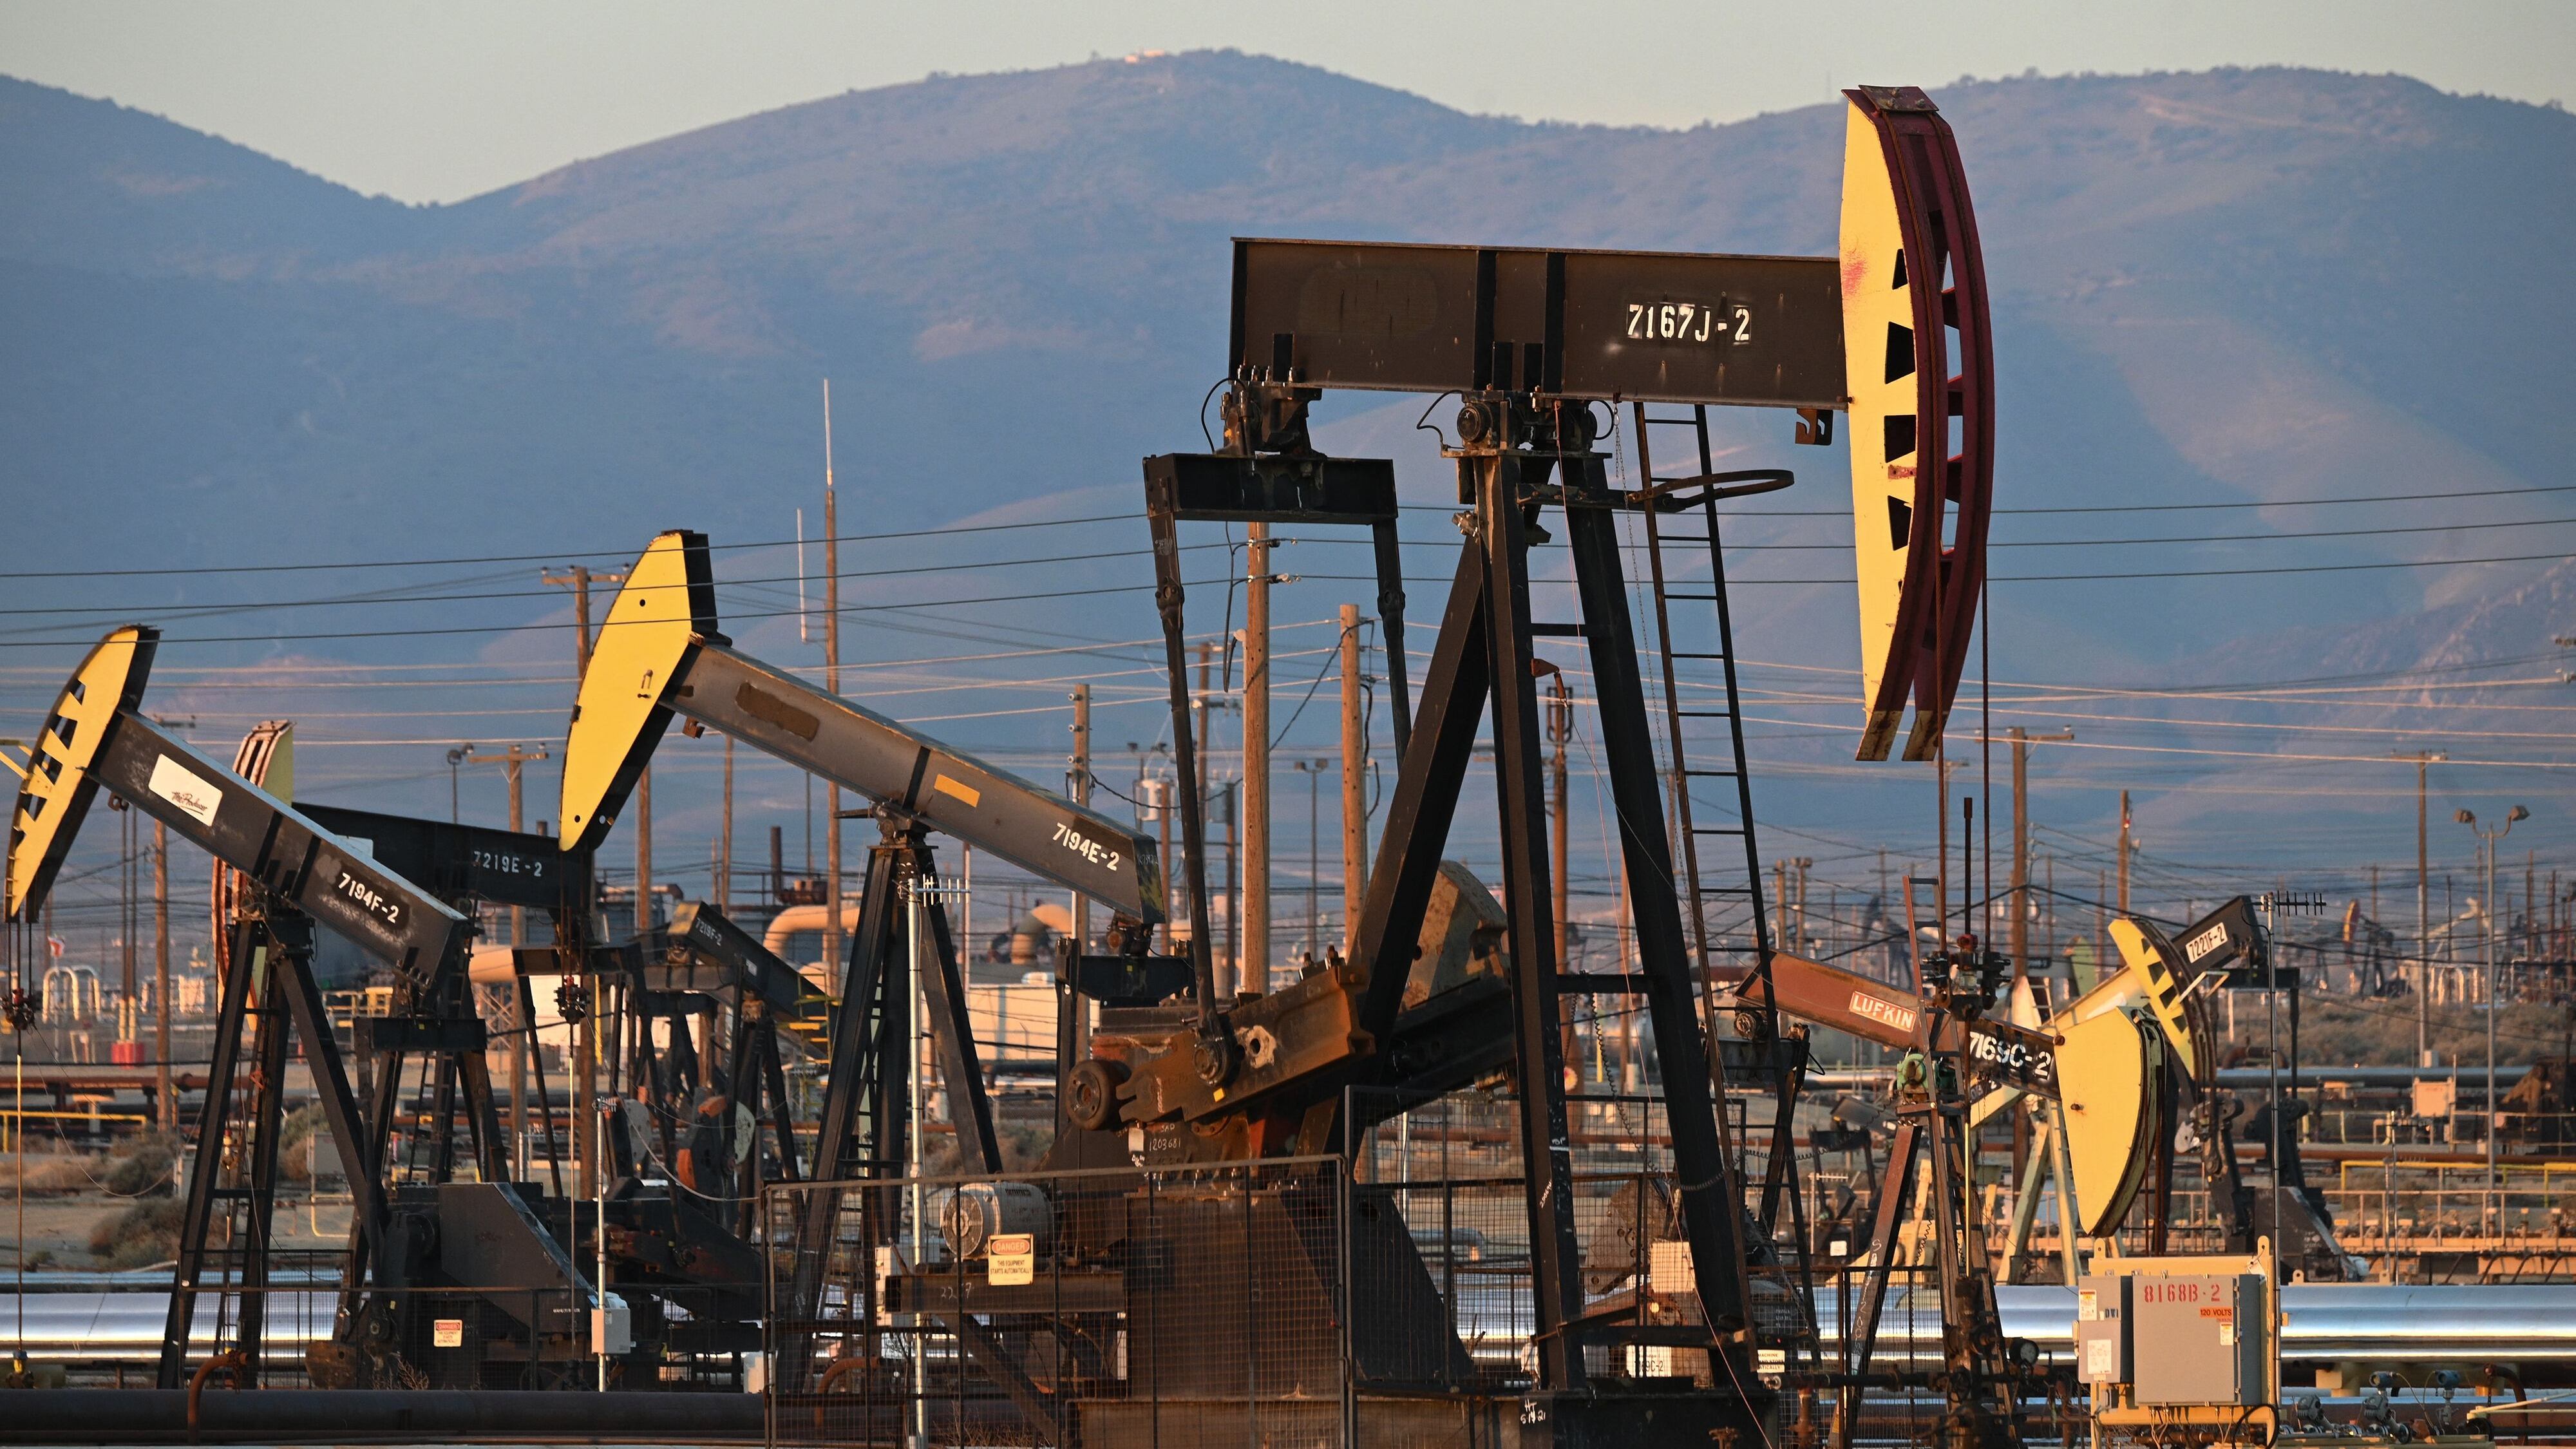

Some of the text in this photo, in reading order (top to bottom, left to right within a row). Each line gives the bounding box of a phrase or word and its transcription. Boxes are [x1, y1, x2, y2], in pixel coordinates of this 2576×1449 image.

[1627, 304, 1749, 342] 7167J-2
[1052, 822, 1119, 871] 7194E-2
[473, 851, 542, 876] 7219E-2
[338, 872, 399, 923] 7194F-2
[696, 917, 722, 947] 7219F-2
[2189, 926, 2225, 960] 7221F-2
[1852, 995, 1913, 1028] LUFKIN
[1969, 1031, 2051, 1076] 7169C-2
[1149, 1137, 1181, 1152] 1203681
[996, 1242, 1025, 1252] DANGER
[941, 1282, 972, 1300] 227
